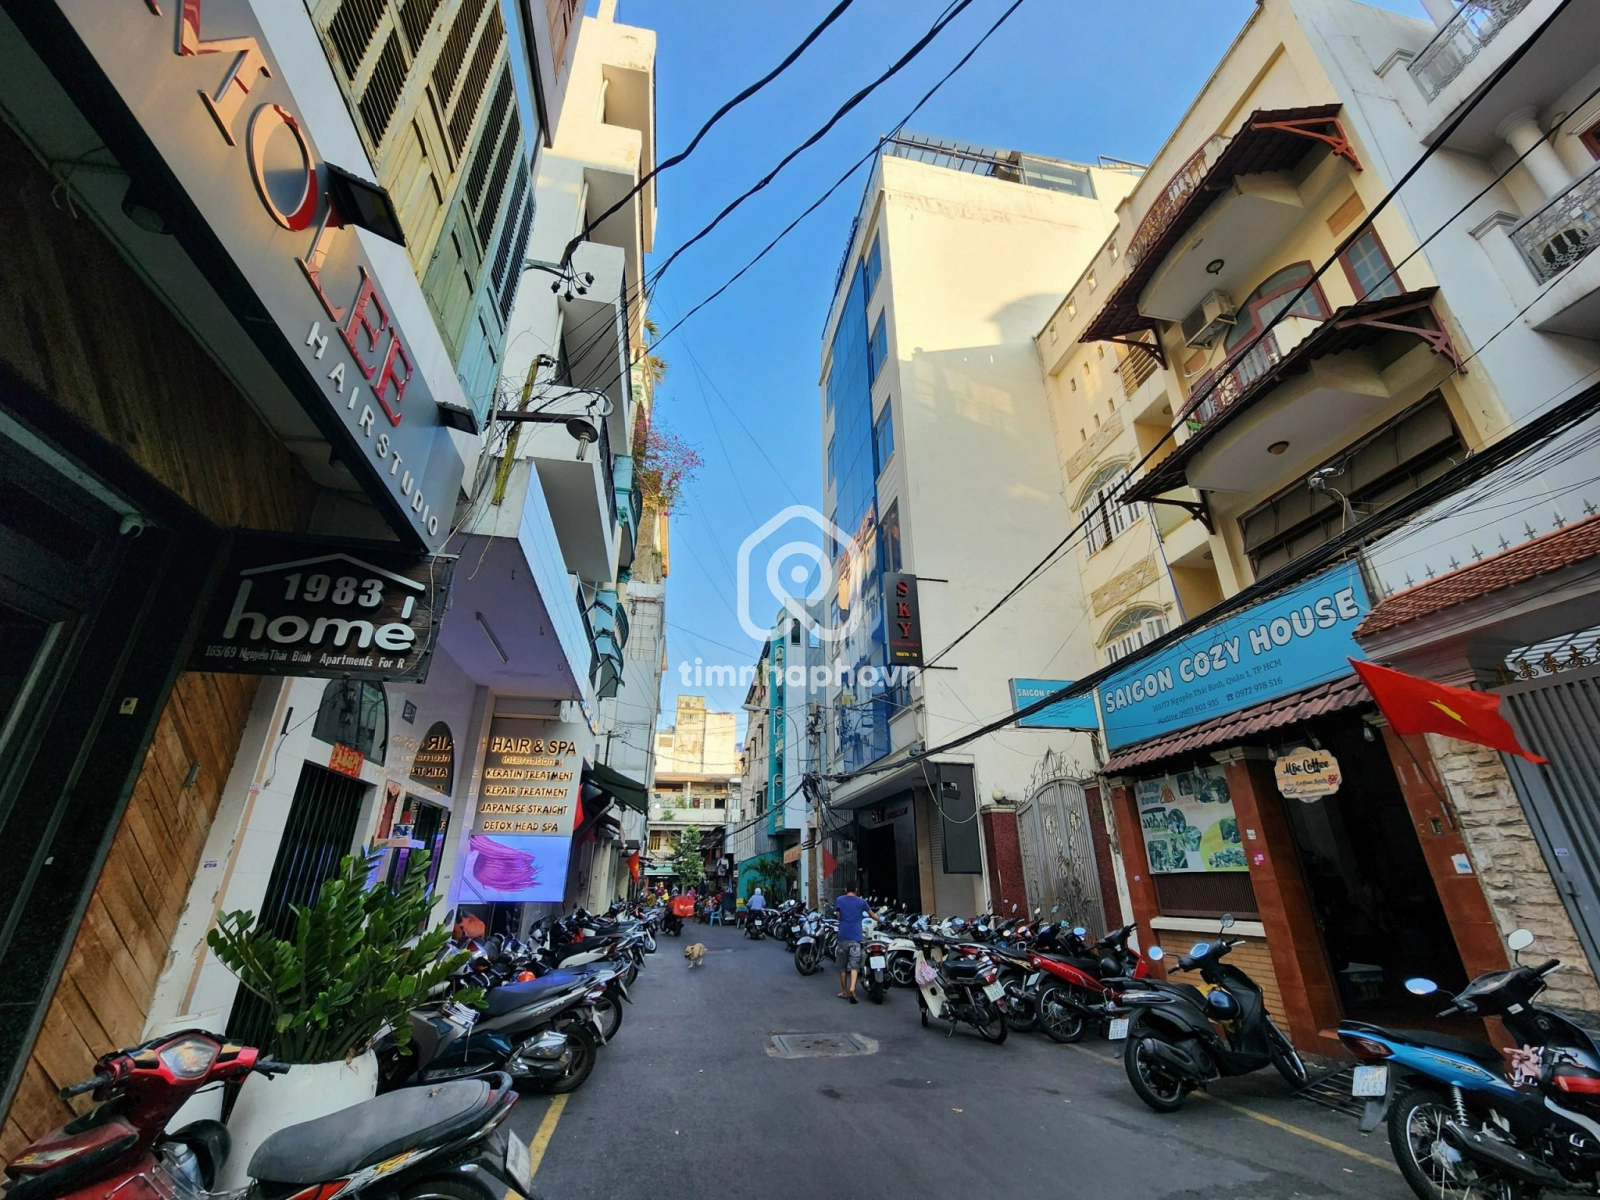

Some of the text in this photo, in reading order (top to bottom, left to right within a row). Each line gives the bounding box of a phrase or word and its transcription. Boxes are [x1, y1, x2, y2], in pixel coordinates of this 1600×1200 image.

[284, 572, 385, 607] 1983
[222, 579, 417, 650] home
[897, 579, 912, 638] SKY
[1105, 586, 1360, 713] SAIGON COZY HOUSE
[319, 652, 373, 666] Apartments
[378, 656, 393, 668] For
[1252, 666, 1262, 675] TP
[1263, 658, 1283, 671] HCM
[1017, 688, 1045, 697] SAIGON
[1235, 676, 1283, 699] 0972 978 516
[1179, 707, 1194, 718] 0903
[1195, 702, 1207, 712] 801
[1207, 698, 1220, 708] 935
[492, 737, 577, 755] HAIR & SPA
[502, 755, 564, 767] international
[1303, 758, 1329, 774] Coffee
[486, 768, 574, 781] KERATIN TREATMENT
[485, 786, 569, 798] REPAIR TREATMENT
[480, 803, 568, 815] JAPANESE STRAIGHT
[483, 821, 558, 833] DETOX HEAD SPA
